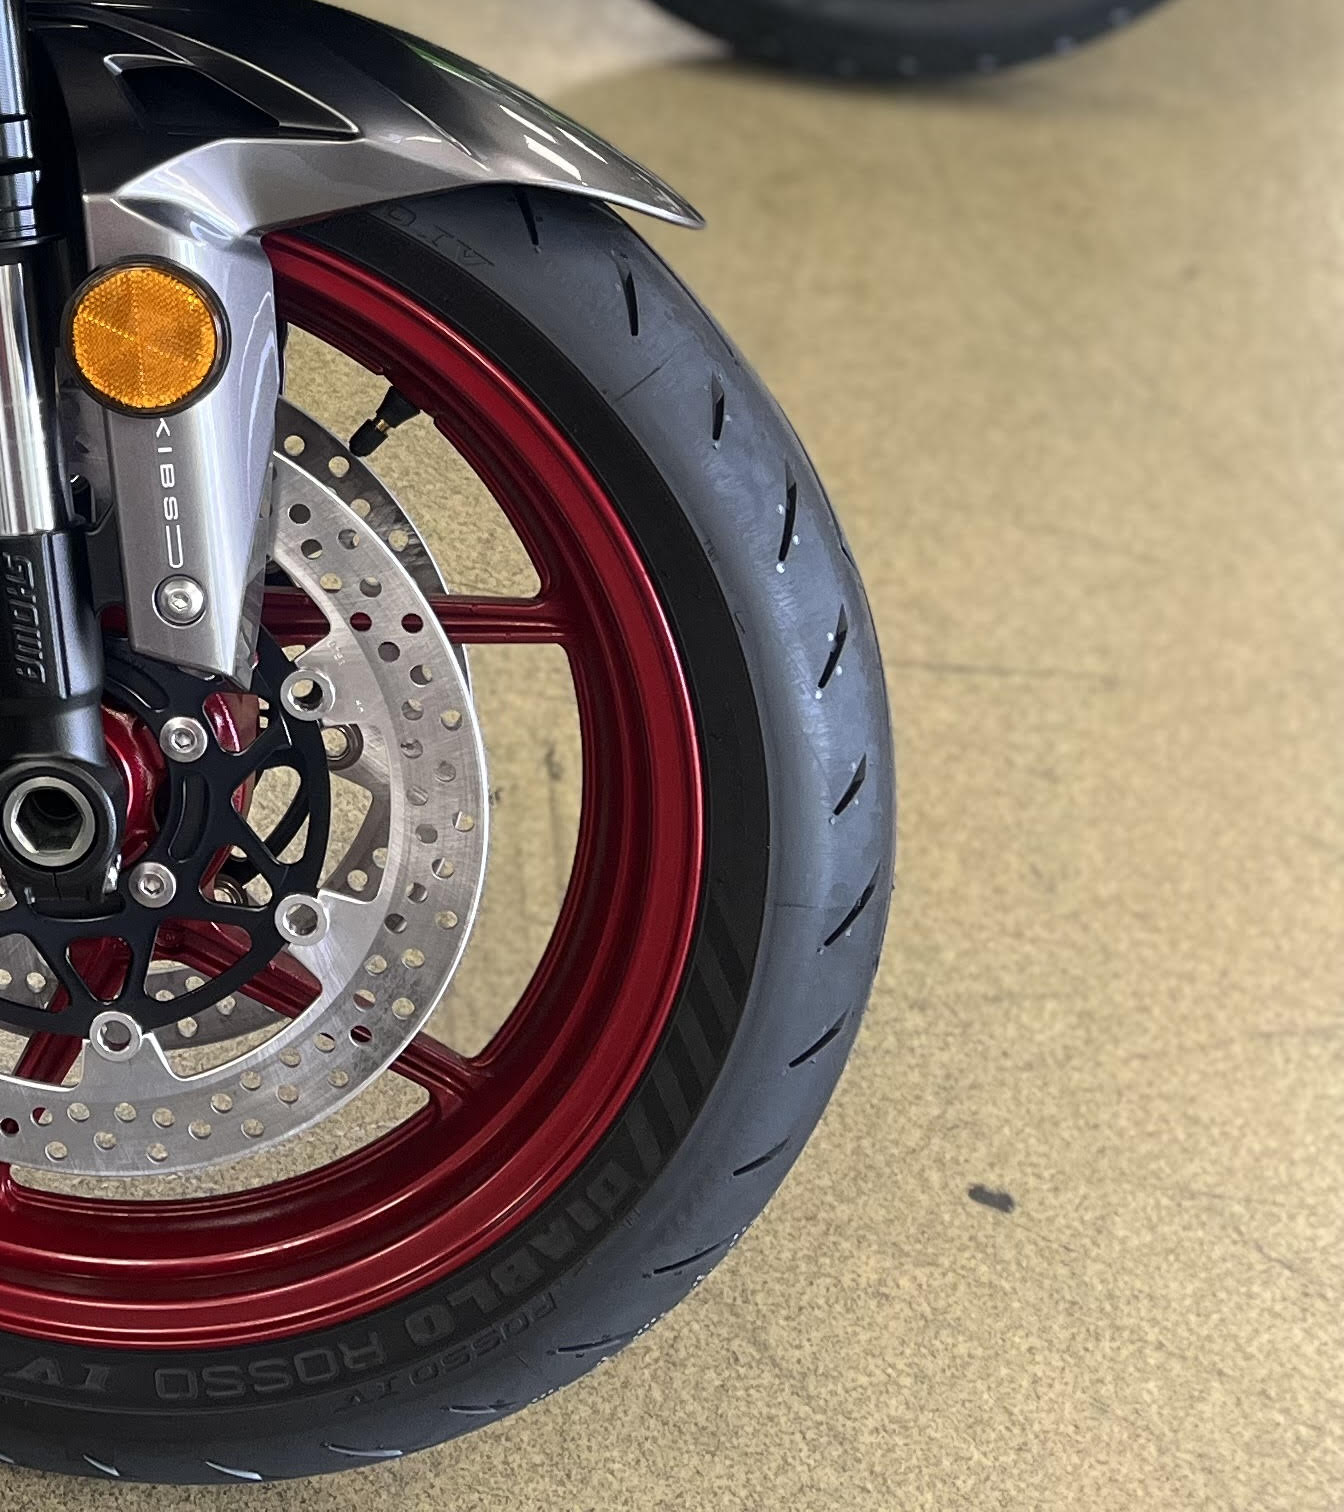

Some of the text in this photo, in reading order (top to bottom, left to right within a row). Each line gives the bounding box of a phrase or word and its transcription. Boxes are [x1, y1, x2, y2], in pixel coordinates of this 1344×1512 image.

[156, 418, 180, 521] KIBS
[2, 552, 46, 683] SHOWA
[3, 1162, 641, 1400] DIABLO ROSSO IV
